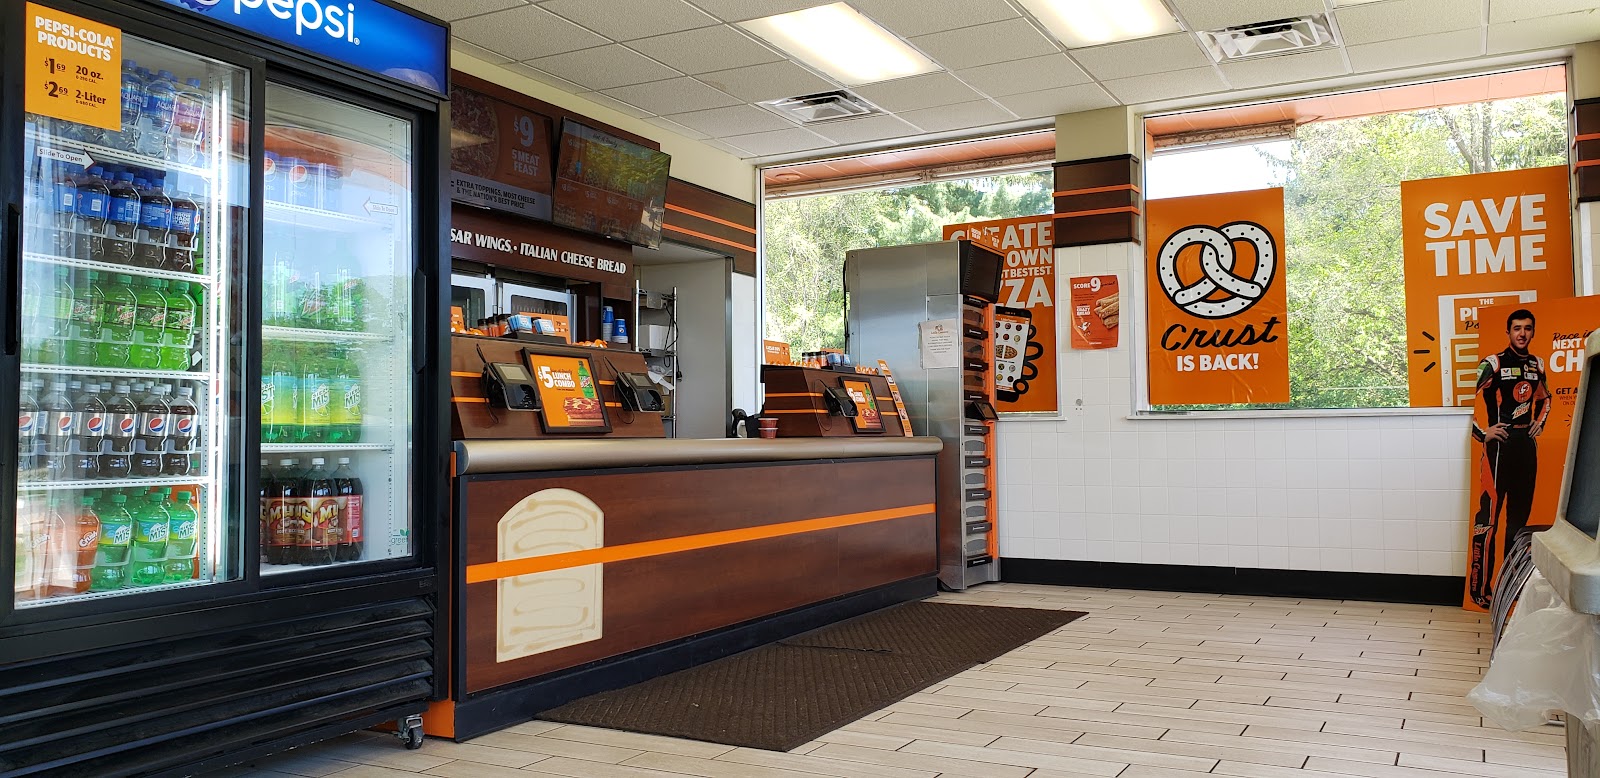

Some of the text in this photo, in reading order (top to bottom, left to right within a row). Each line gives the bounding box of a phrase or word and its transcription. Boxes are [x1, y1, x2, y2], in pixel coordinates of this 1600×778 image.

[38, 31, 111, 61] PRODUCTS
[75, 65, 88, 76] 20
[90, 70, 104, 80] oz.
[75, 90, 107, 104] 2-Liter
[514, 114, 534, 147] $9
[39, 148, 83, 163] Slide To Open
[517, 151, 540, 166] MEAT
[514, 161, 538, 176] FEAST
[456, 179, 536, 205] EXTRA TOPPINGS, MOST CHEESE
[461, 188, 473, 197] THE
[473, 191, 498, 203] NATION'S
[498, 197, 510, 206] BEST
[1424, 193, 1547, 239] SAVE
[520, 243, 558, 262] ITALIAN
[561, 251, 595, 269] CHEESE
[597, 258, 627, 275] BREAD
[1006, 248, 1053, 267] OWN
[1425, 234, 1547, 277] TIME
[1460, 307, 1478, 321] PI
[1465, 320, 1479, 330] Po
[1161, 317, 1281, 351] Crust
[1553, 332, 1579, 341] Race
[1552, 338, 1582, 350] NEXT
[1177, 353, 1259, 372] IS BACK!
[1550, 349, 1584, 373] CH
[538, 365, 554, 389] $5
[552, 371, 572, 380] LUNCH
[554, 379, 576, 388] COMBO
[1556, 387, 1571, 395] GET
[149, 527, 166, 541] MIS
[179, 526, 194, 539] MIS
